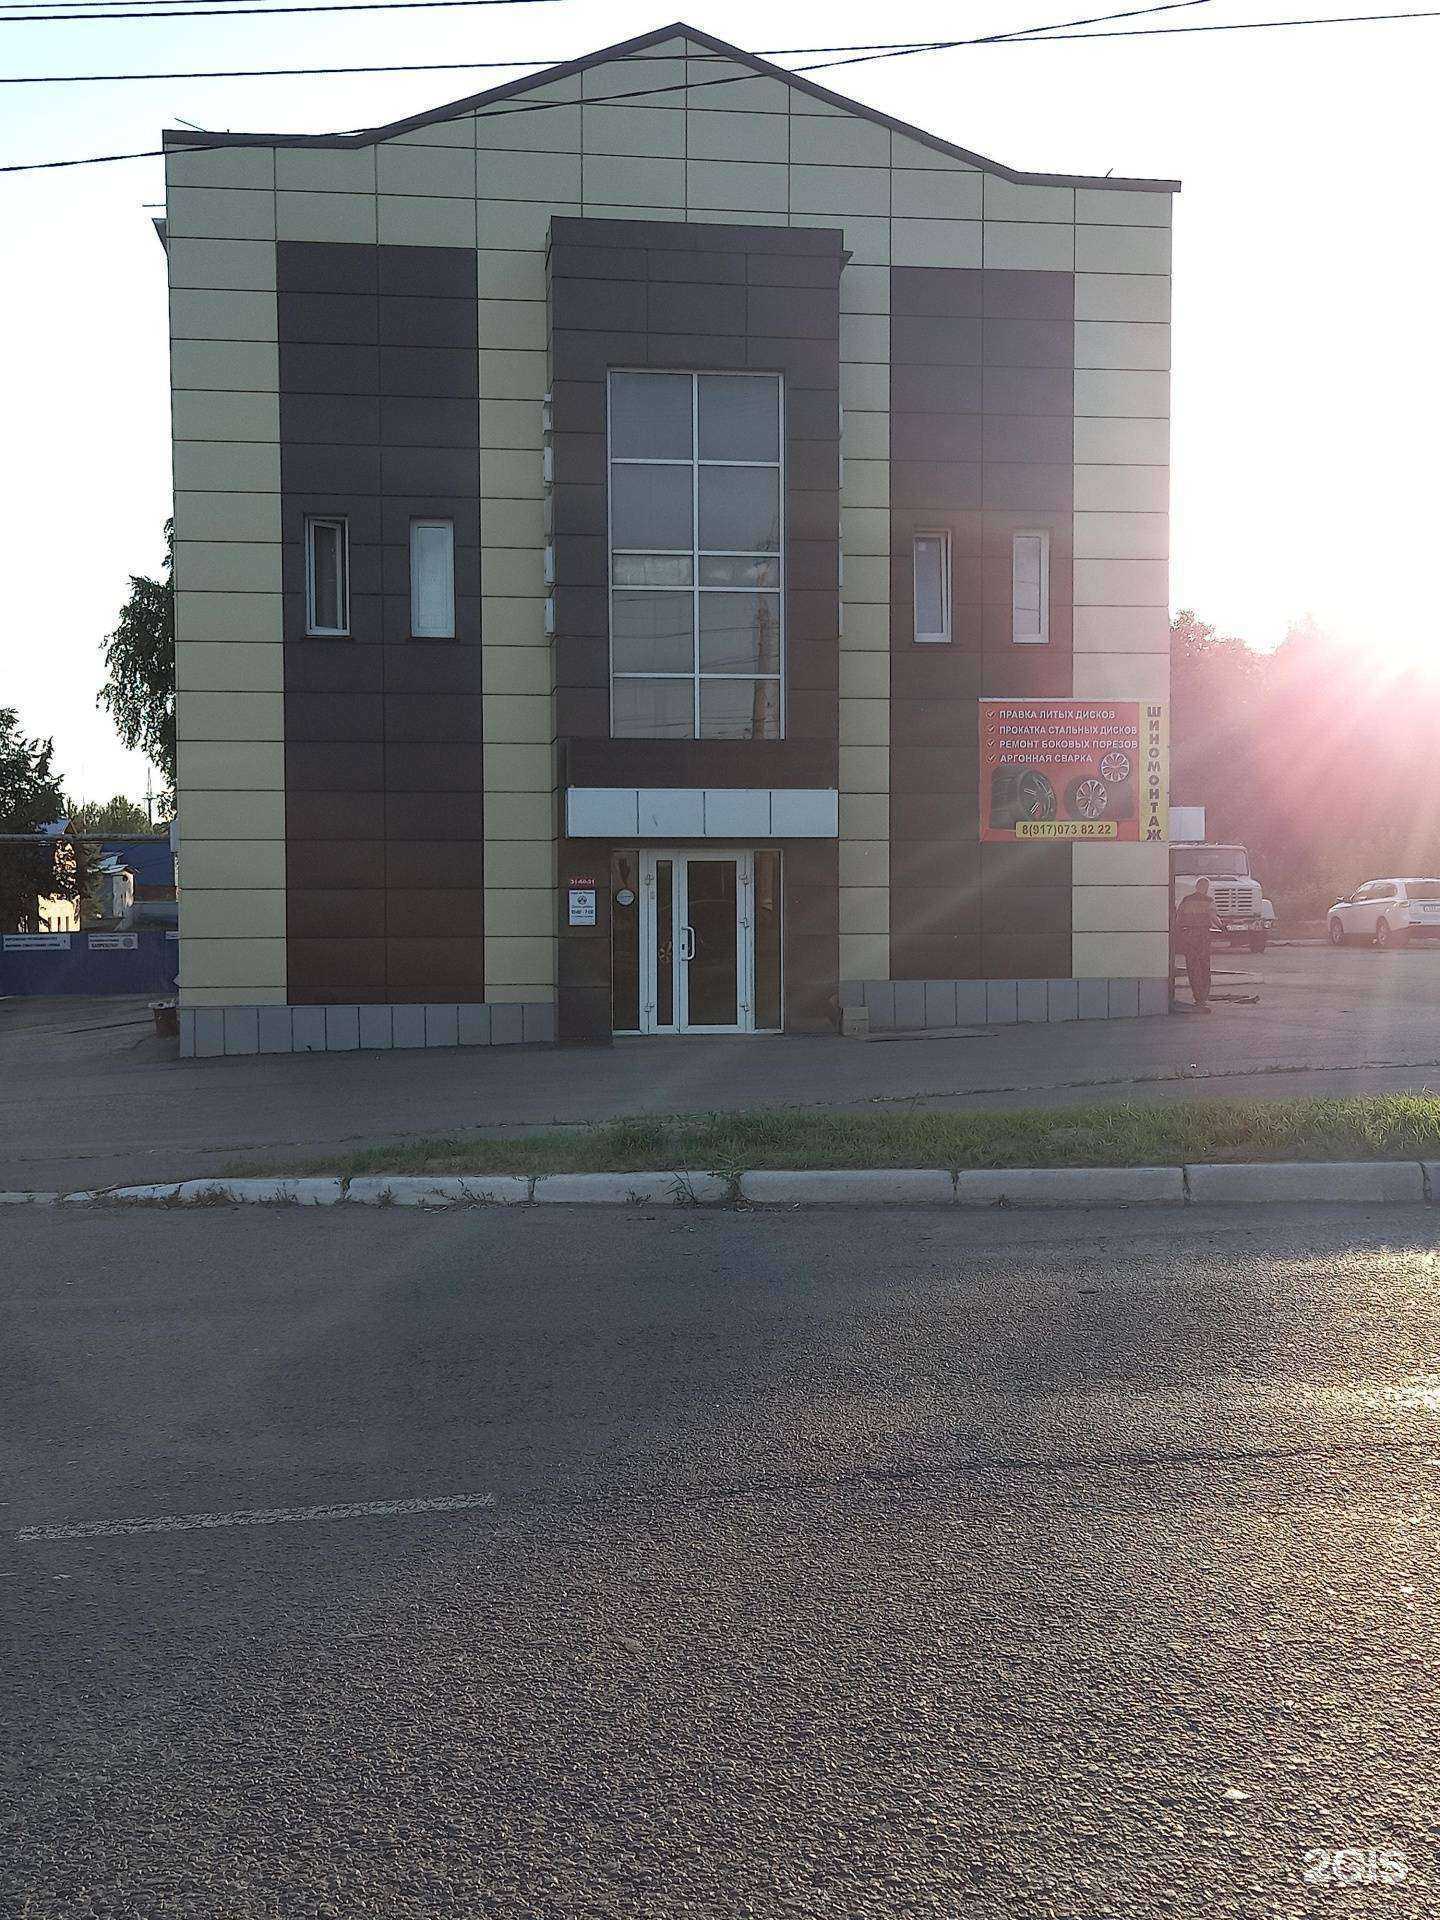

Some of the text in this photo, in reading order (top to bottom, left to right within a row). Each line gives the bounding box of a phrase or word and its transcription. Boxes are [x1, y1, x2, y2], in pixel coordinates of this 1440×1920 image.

[999, 710, 1116, 720] ПРАВКА ЛИТЫХ ДИСКОВ
[999, 725, 1137, 735] ПРОКАТКА СТАЛЬНЫХ ДИСКОВ
[999, 740, 1138, 749] РЕМОНТ БОКОВЫХ ПОРЕЗОВ
[999, 754, 1093, 763] АРГОННАЯ СВАРКА
[1147, 706, 1162, 841] ШИНОМОНТАЖ
[1021, 824, 1112, 836] 8(917)073 82 22
